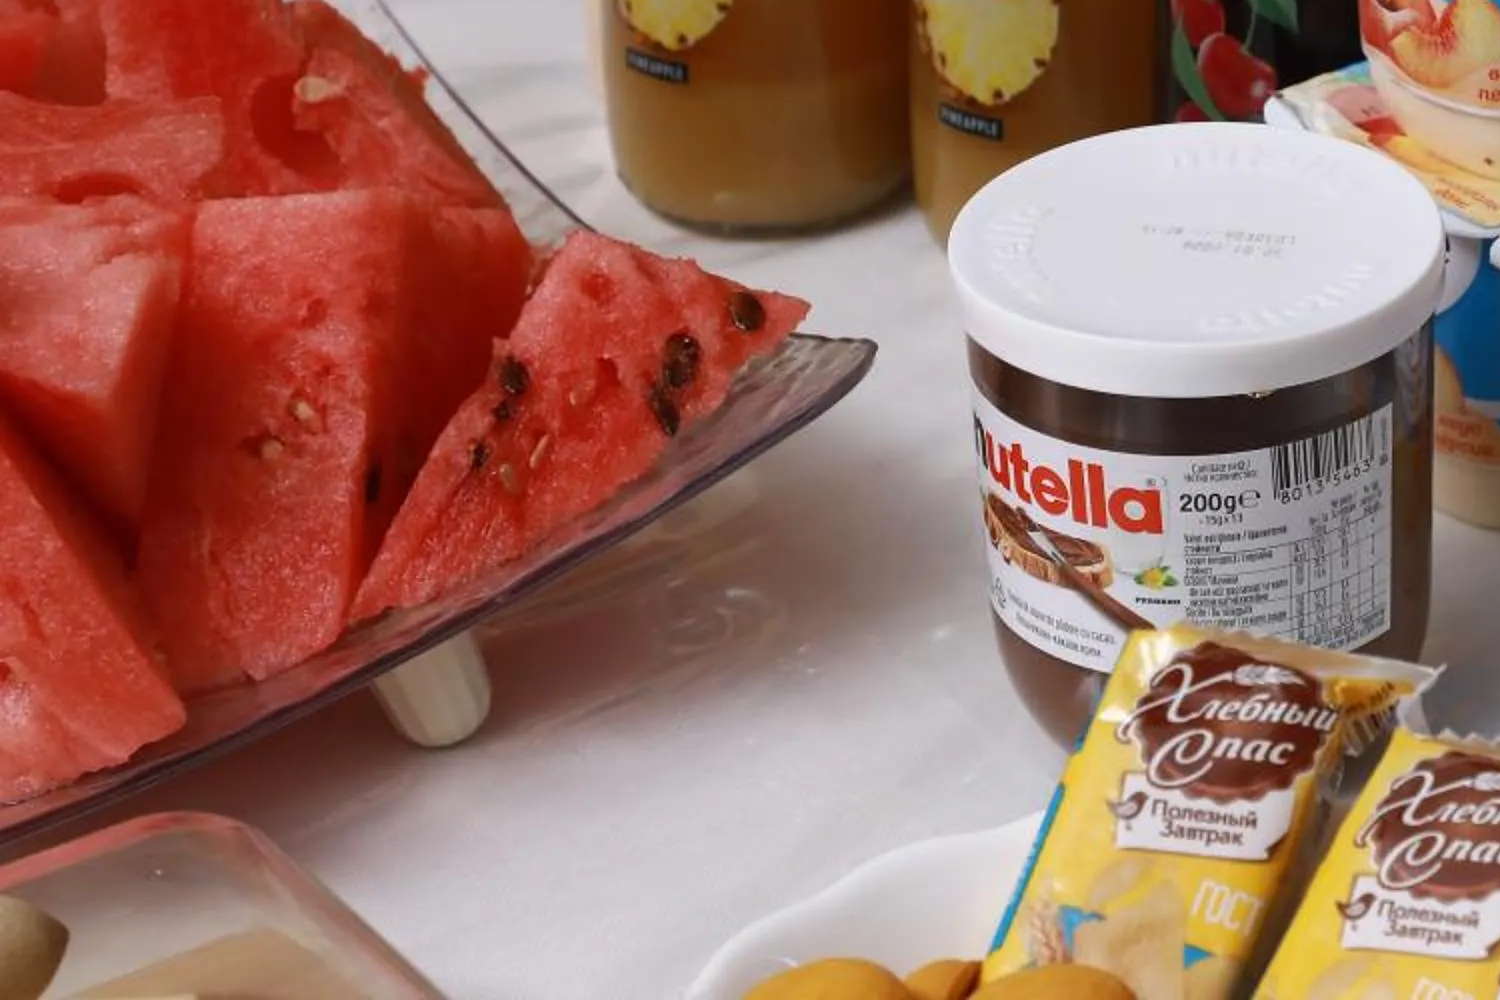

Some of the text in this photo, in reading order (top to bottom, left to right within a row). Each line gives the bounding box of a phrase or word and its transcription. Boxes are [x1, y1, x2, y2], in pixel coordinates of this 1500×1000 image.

[974, 411, 1163, 534] nutella
[1115, 662, 1339, 741] Хлебный
[1146, 727, 1295, 788] Спас
[1151, 799, 1259, 830] Полезный
[1160, 819, 1244, 848] Завтрак
[1192, 881, 1263, 935] ГОСТ
[1378, 900, 1480, 928] Полезный
[1384, 920, 1464, 945] Завтрак
